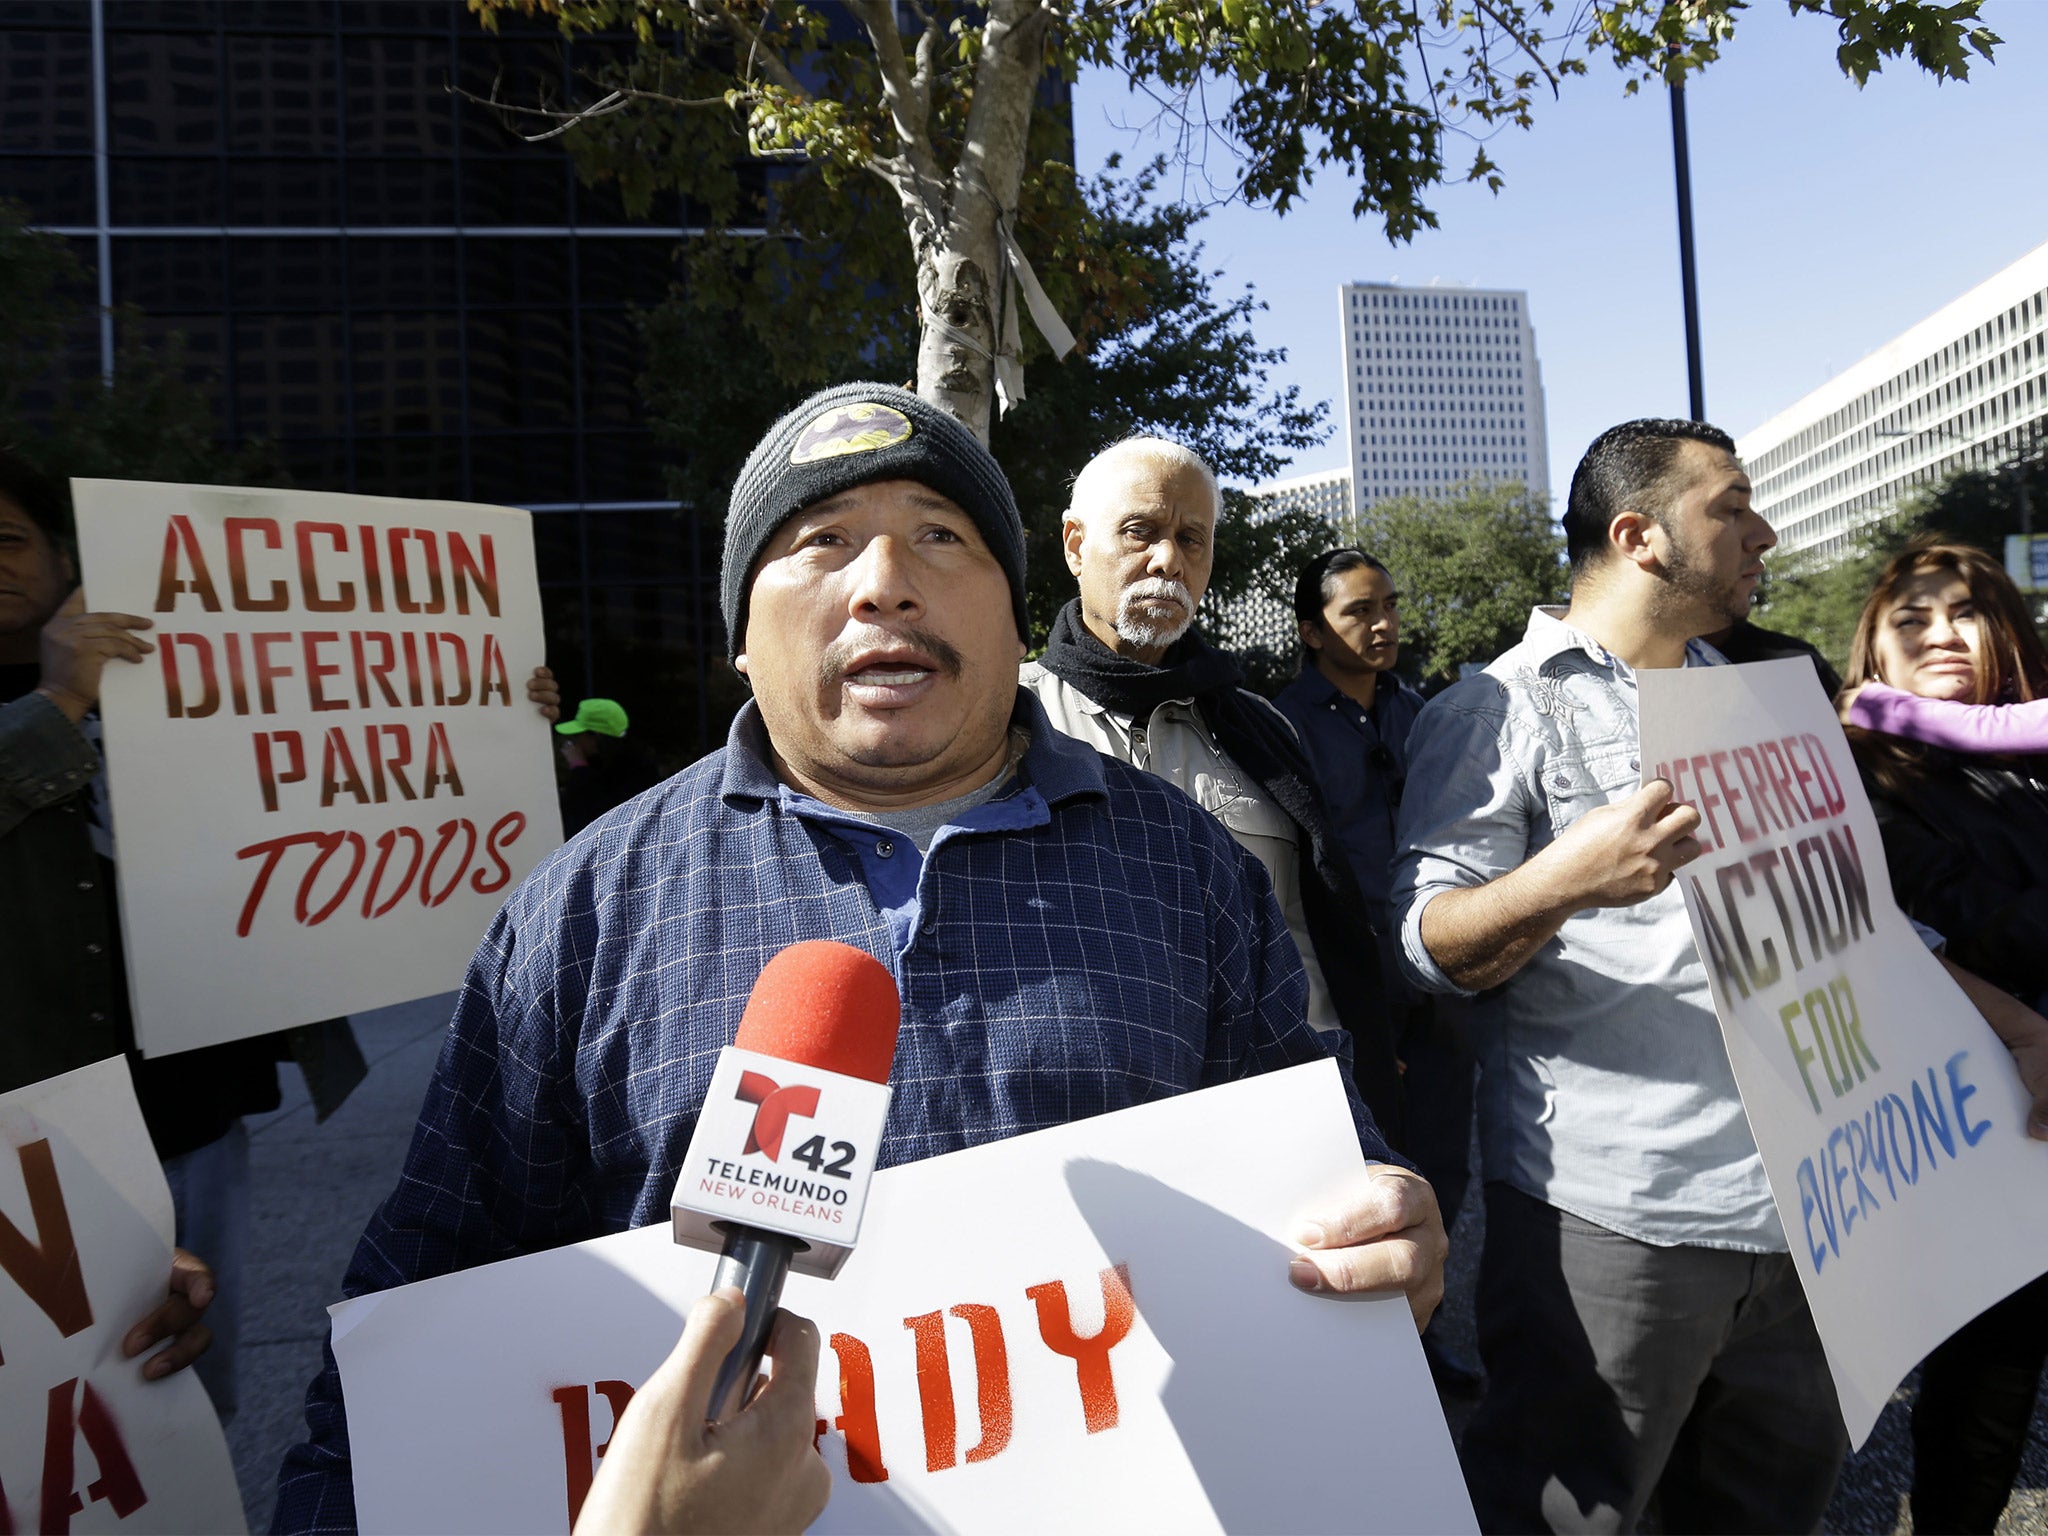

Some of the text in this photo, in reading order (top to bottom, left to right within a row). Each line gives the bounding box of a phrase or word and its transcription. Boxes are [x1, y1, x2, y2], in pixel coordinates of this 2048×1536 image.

[154, 515, 501, 617] ACCION
[157, 631, 512, 719] DIFERIDA
[253, 722, 464, 812] PARA
[235, 811, 526, 938] TODOS
[1692, 823, 1877, 1011] ACTION
[1778, 972, 1880, 1115] FOR
[699, 1178, 843, 1224] NEW ORLEANS
[708, 1158, 848, 1206] TELEMUNDO
[792, 1135, 856, 1180] 42
[1796, 1050, 1993, 1275] EVERYONE
[552, 1263, 1136, 1536] ADY
